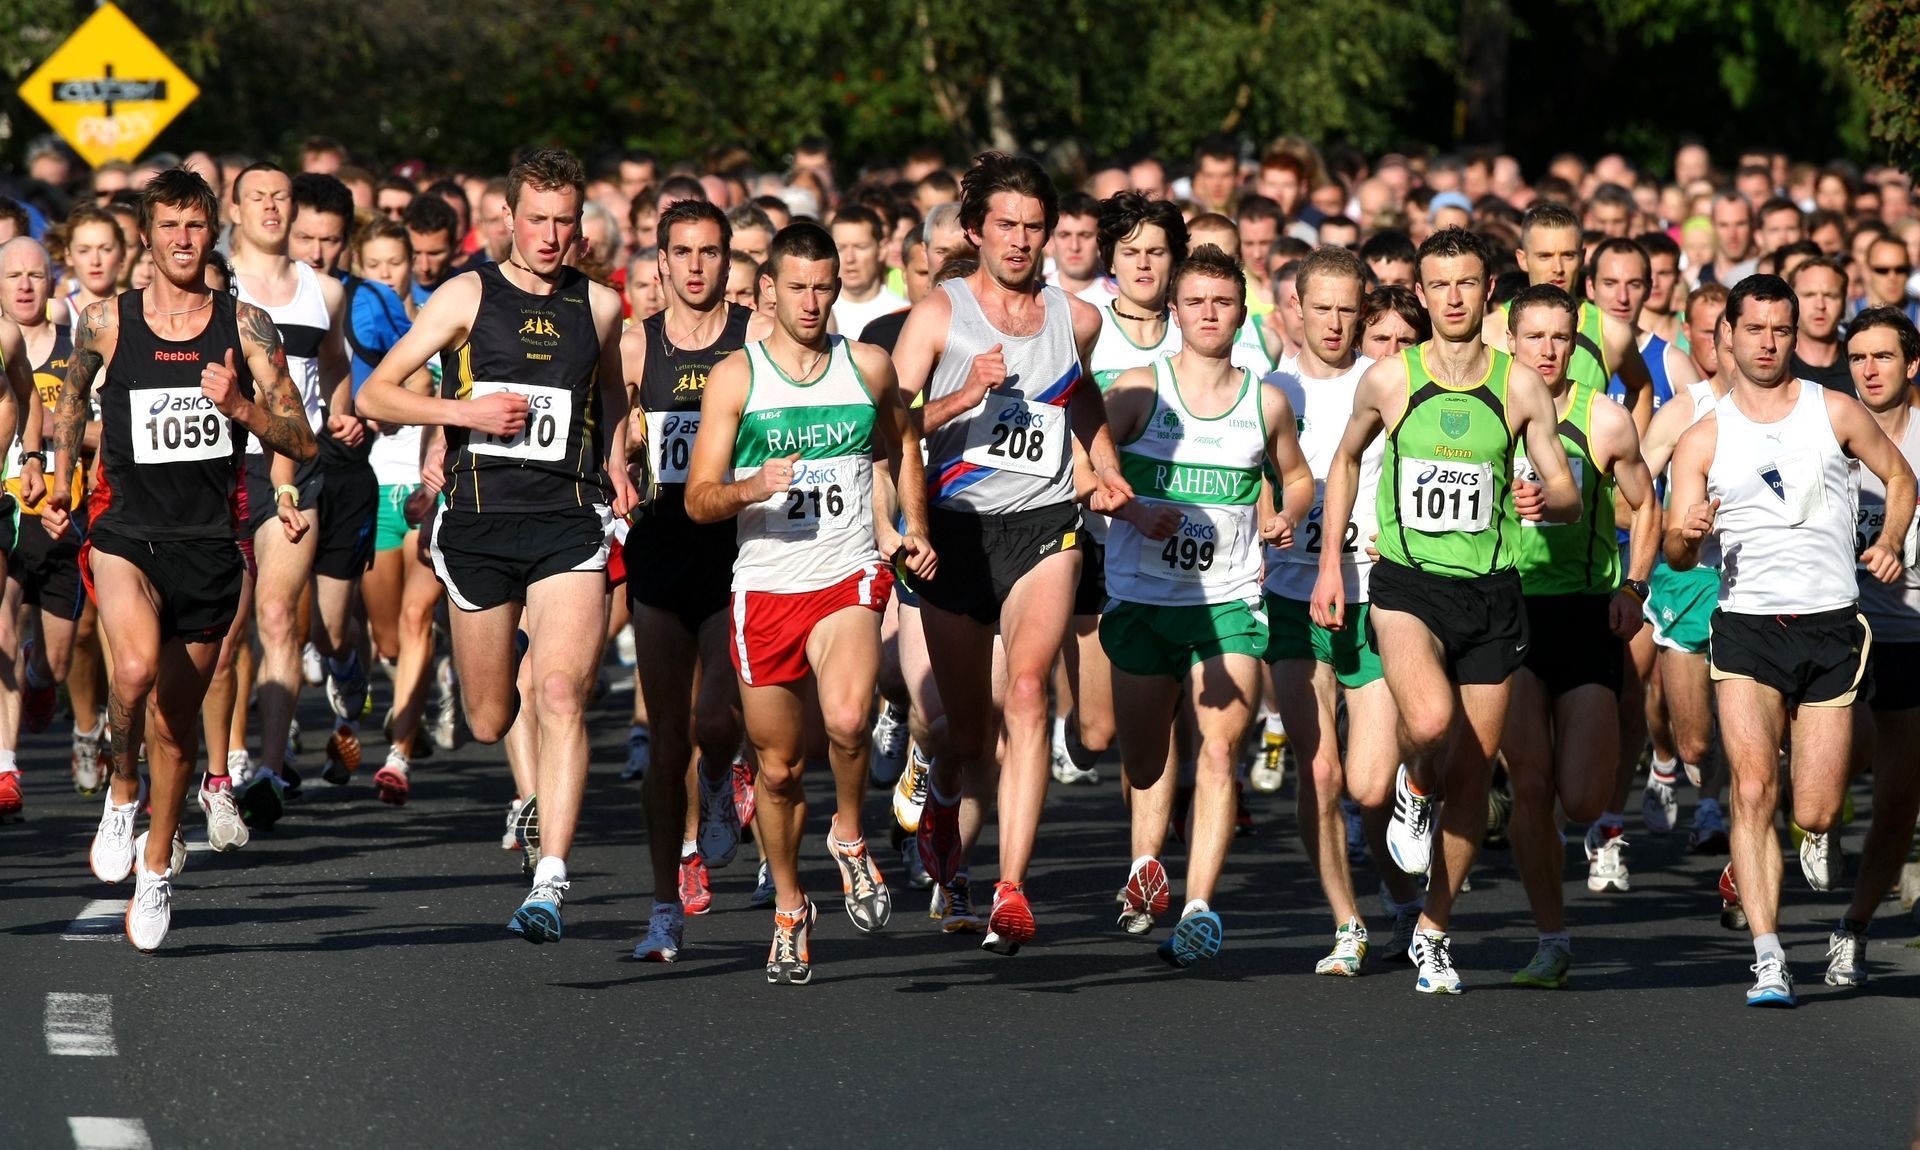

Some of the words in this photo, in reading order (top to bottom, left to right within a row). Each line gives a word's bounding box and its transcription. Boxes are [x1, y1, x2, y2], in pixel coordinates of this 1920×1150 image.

[154, 350, 200, 361] Reebok
[145, 414, 220, 450] 1059
[1014, 408, 1044, 428] asics
[766, 421, 857, 451] RAHENY
[987, 423, 1044, 462] 208
[1434, 445, 1472, 459] Flynn
[660, 438, 689, 470] 10
[806, 468, 837, 485] asics
[1154, 464, 1244, 497] RAHENY
[1437, 470, 1479, 486] asics
[787, 484, 844, 520] 216
[1412, 486, 1480, 520] 1011
[1184, 522, 1215, 540] asics
[1305, 522, 1359, 554] 22
[1162, 535, 1215, 571] 499
